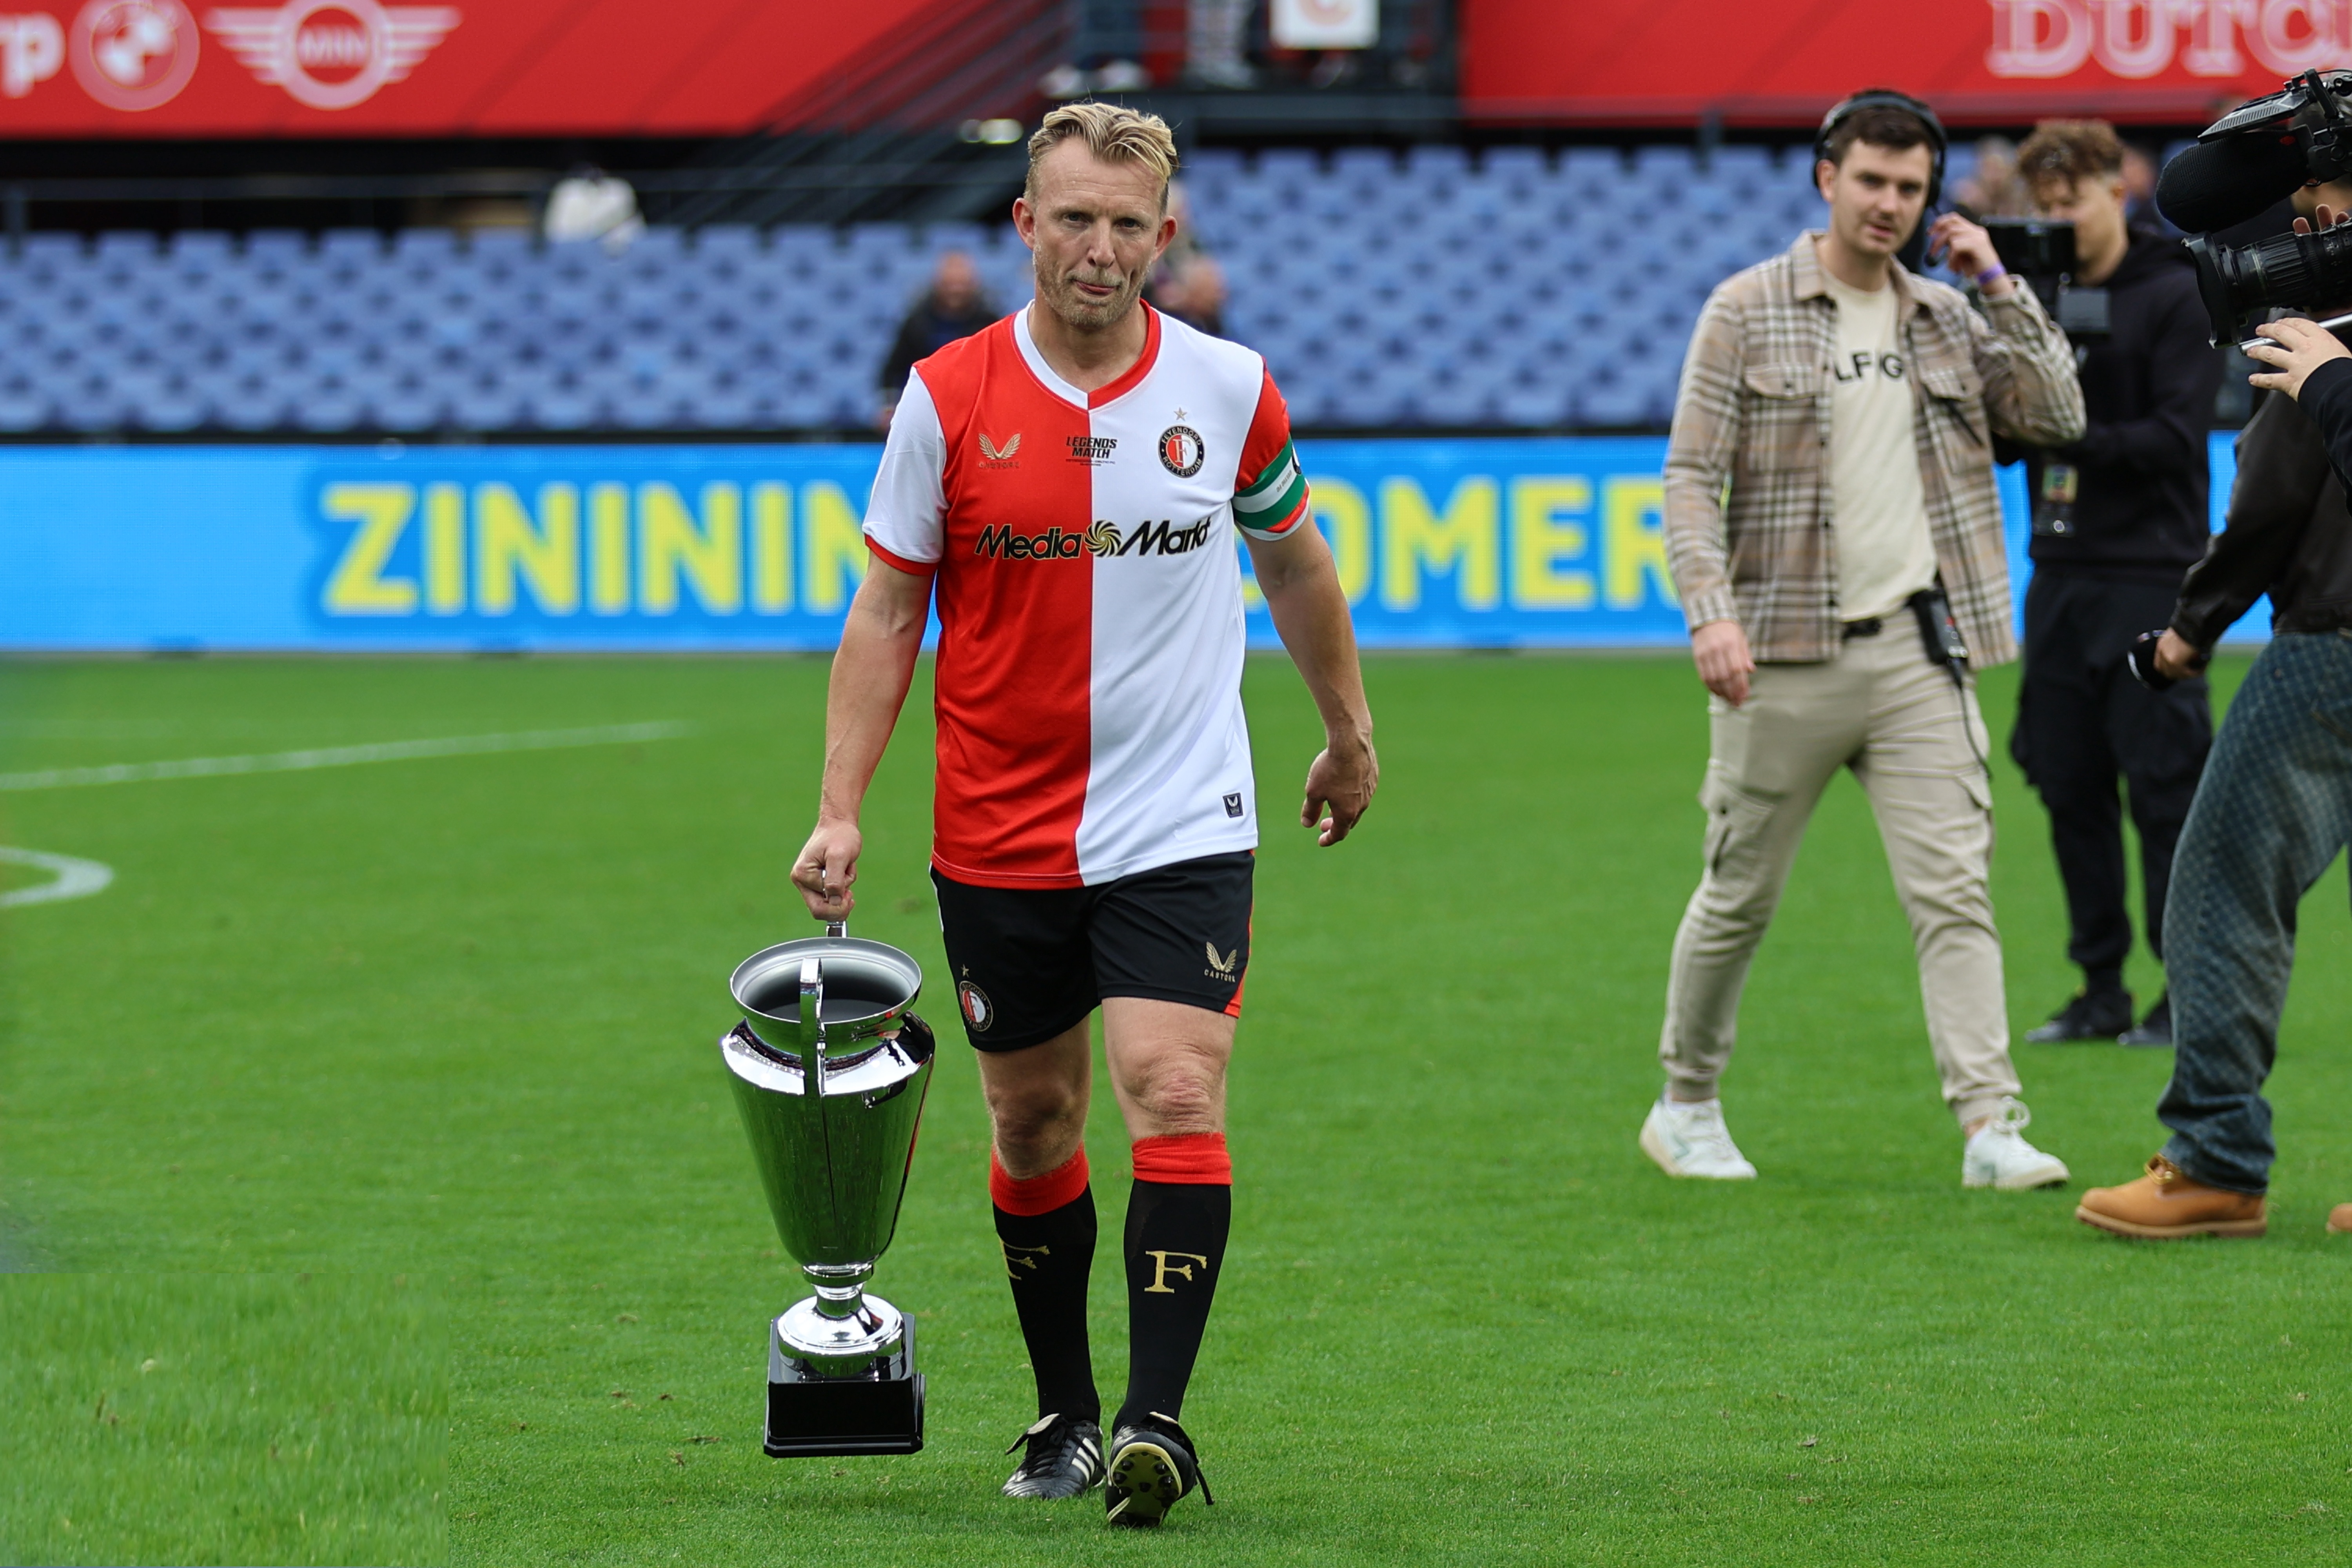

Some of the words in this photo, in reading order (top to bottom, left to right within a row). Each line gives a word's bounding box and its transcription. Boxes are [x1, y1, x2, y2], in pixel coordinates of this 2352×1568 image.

[1984, 0, 2352, 78] DUTC
[1065, 436, 1118, 448] LEGENDS
[1161, 426, 1202, 445] FEYENOORD
[1072, 447, 1111, 459] MATCH
[1163, 456, 1202, 476] ROTTERDAM
[975, 524, 1081, 560] Media
[1115, 516, 1212, 556] Markt
[1237, 475, 1683, 611] OMER
[1144, 1250, 1207, 1293] F
